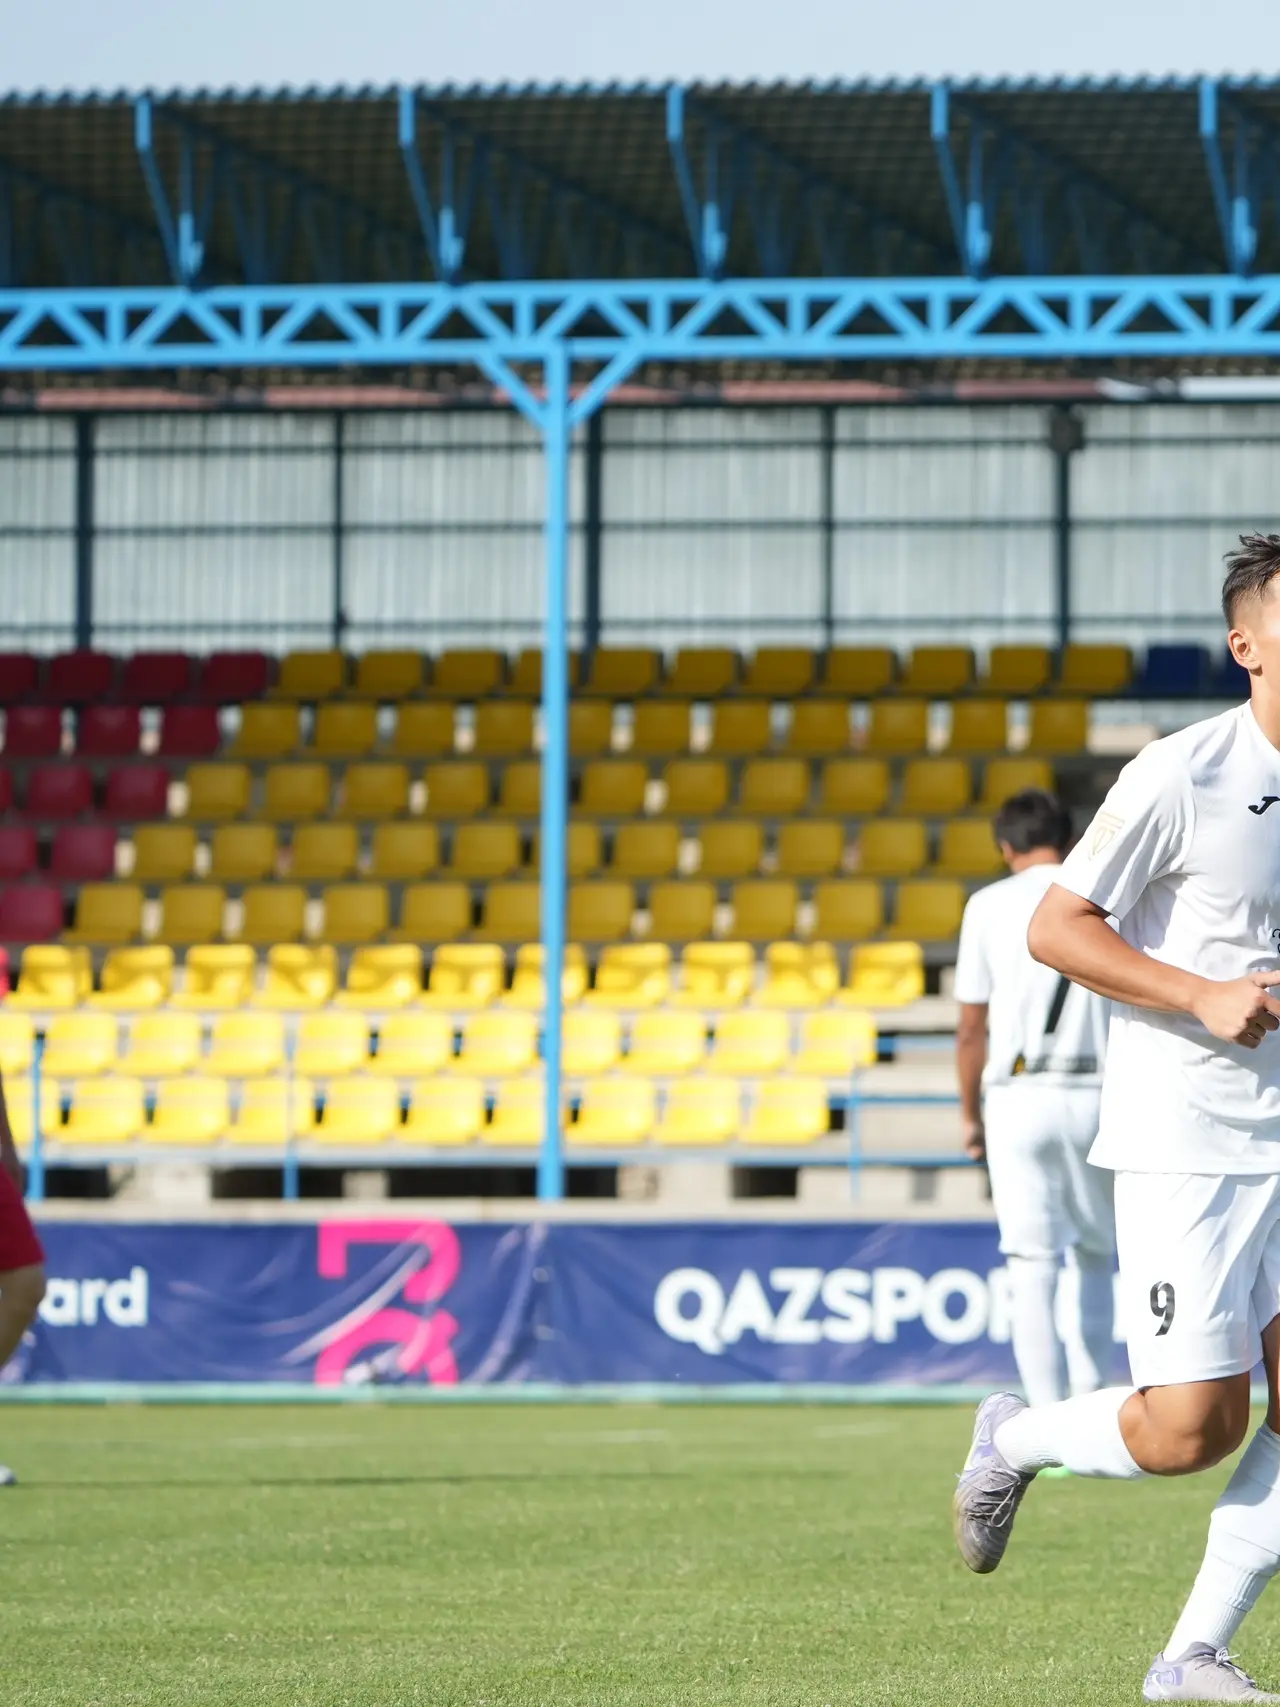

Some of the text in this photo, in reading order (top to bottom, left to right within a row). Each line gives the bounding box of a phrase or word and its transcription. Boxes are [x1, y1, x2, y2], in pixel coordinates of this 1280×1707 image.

[38, 1266, 149, 1326] ard
[653, 1267, 1014, 1355] QAZSPO
[1150, 1280, 1175, 1336] 9
